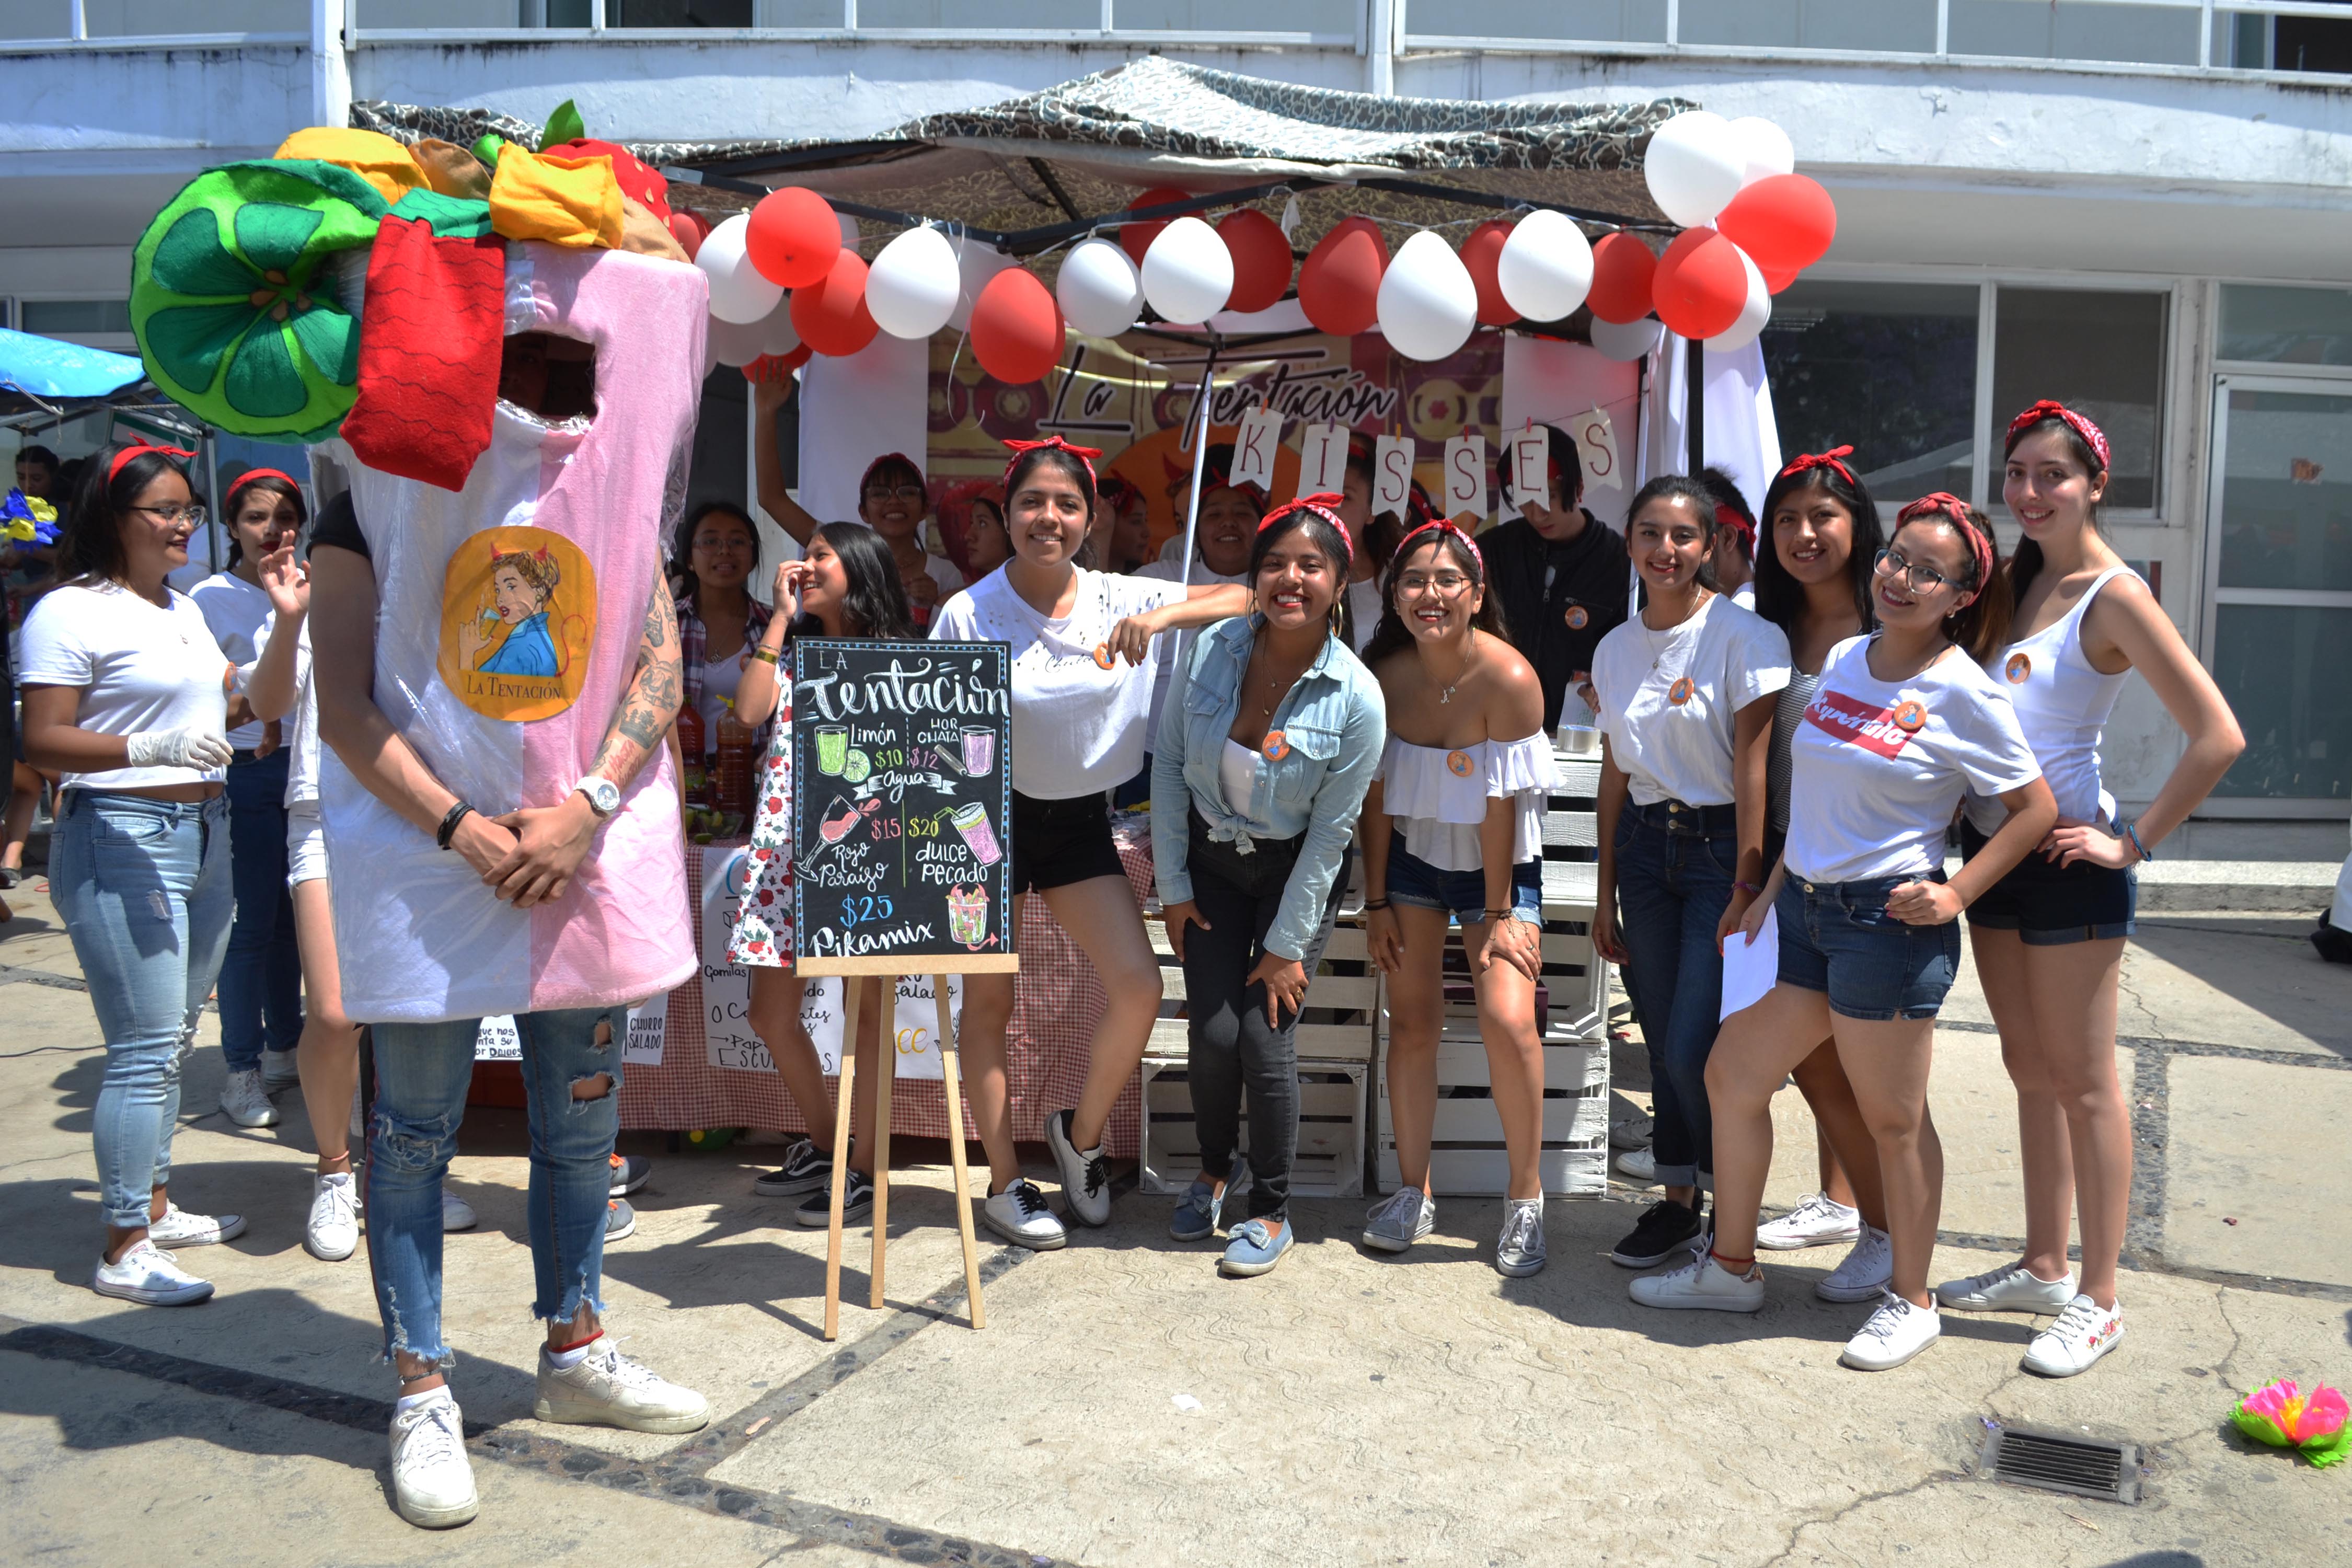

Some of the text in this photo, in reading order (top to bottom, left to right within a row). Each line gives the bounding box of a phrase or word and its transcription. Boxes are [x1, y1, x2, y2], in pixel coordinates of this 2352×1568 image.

[1039, 344, 1394, 448] La Tentación
[820, 651, 847, 670] LA
[794, 658, 1010, 721] Tentación
[851, 722, 896, 747] Limón
[931, 718, 959, 730] HOR
[917, 731, 960, 743] CHATA
[874, 748, 903, 769] $10
[909, 747, 939, 769] $12
[871, 818, 901, 841] $15
[908, 816, 939, 839] $20
[831, 842, 870, 872] Rojo
[840, 894, 893, 930] $25
[809, 921, 935, 957] Pikamix
[497, 1028, 515, 1036] nos
[630, 1018, 663, 1030] CHURRO
[629, 1034, 661, 1050] SALADO
